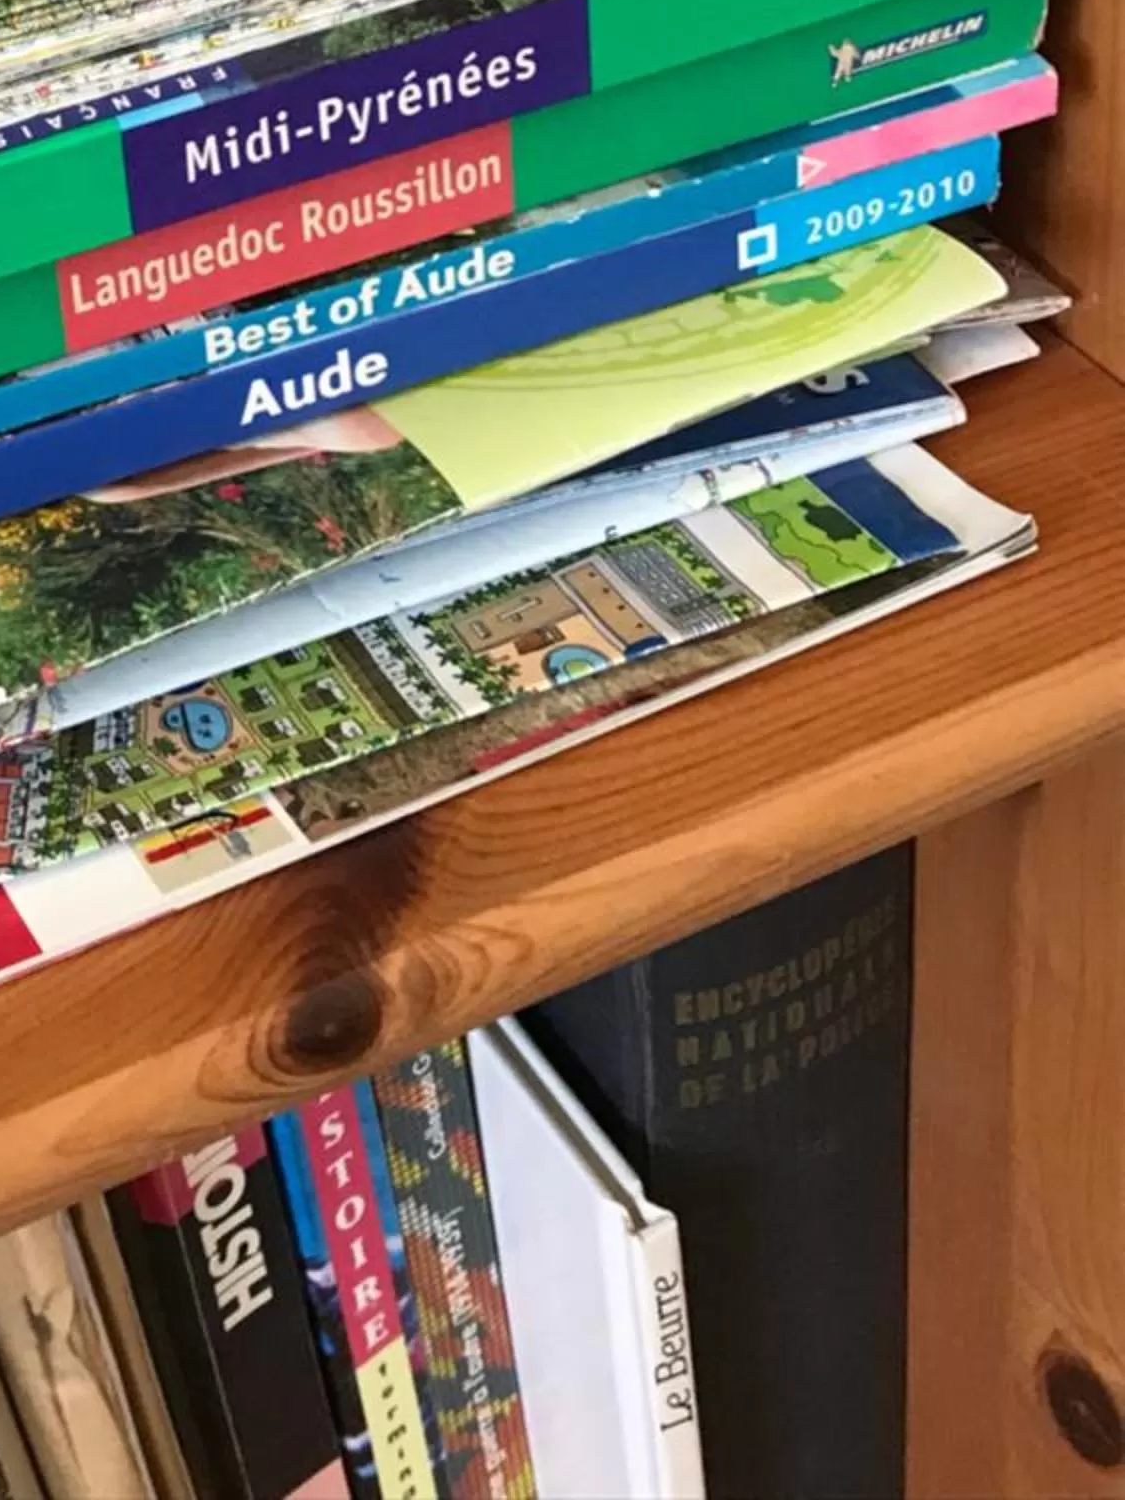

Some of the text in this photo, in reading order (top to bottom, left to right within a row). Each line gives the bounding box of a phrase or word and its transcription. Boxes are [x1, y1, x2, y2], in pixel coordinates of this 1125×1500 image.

[861, 14, 984, 66] MICHELIN
[184, 43, 539, 184] Midi-Pyrénées
[70, 151, 505, 318] Languedoc Roussillon
[806, 169, 977, 245] 2009-2010
[203, 245, 518, 365] Best of Aude
[239, 348, 391, 426] Aude
[319, 1092, 390, 1350] STOIRE
[652, 1271, 694, 1433] Le Beurre
